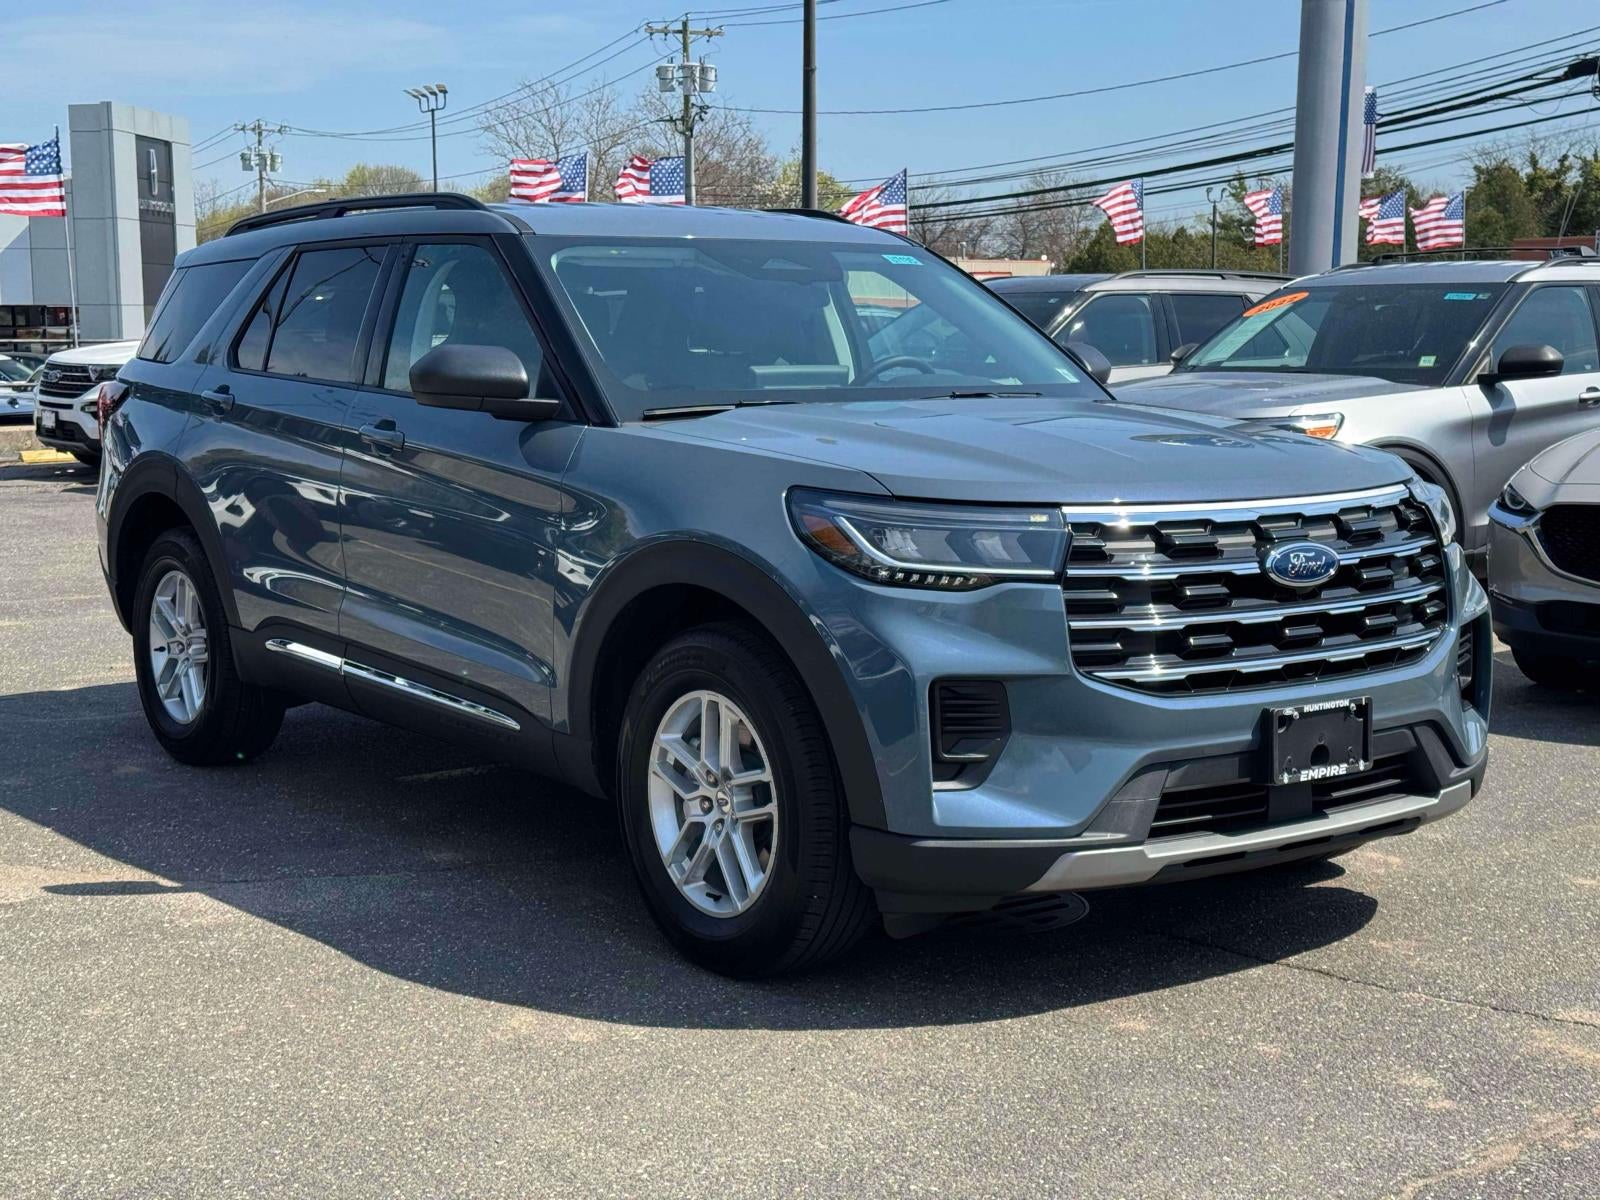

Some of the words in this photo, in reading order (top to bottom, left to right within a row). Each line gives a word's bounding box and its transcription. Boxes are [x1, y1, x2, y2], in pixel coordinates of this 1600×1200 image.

[1289, 551, 1326, 577] Ford
[1303, 698, 1350, 713] HUNTINGTON
[1300, 763, 1348, 782] EMPIRE
